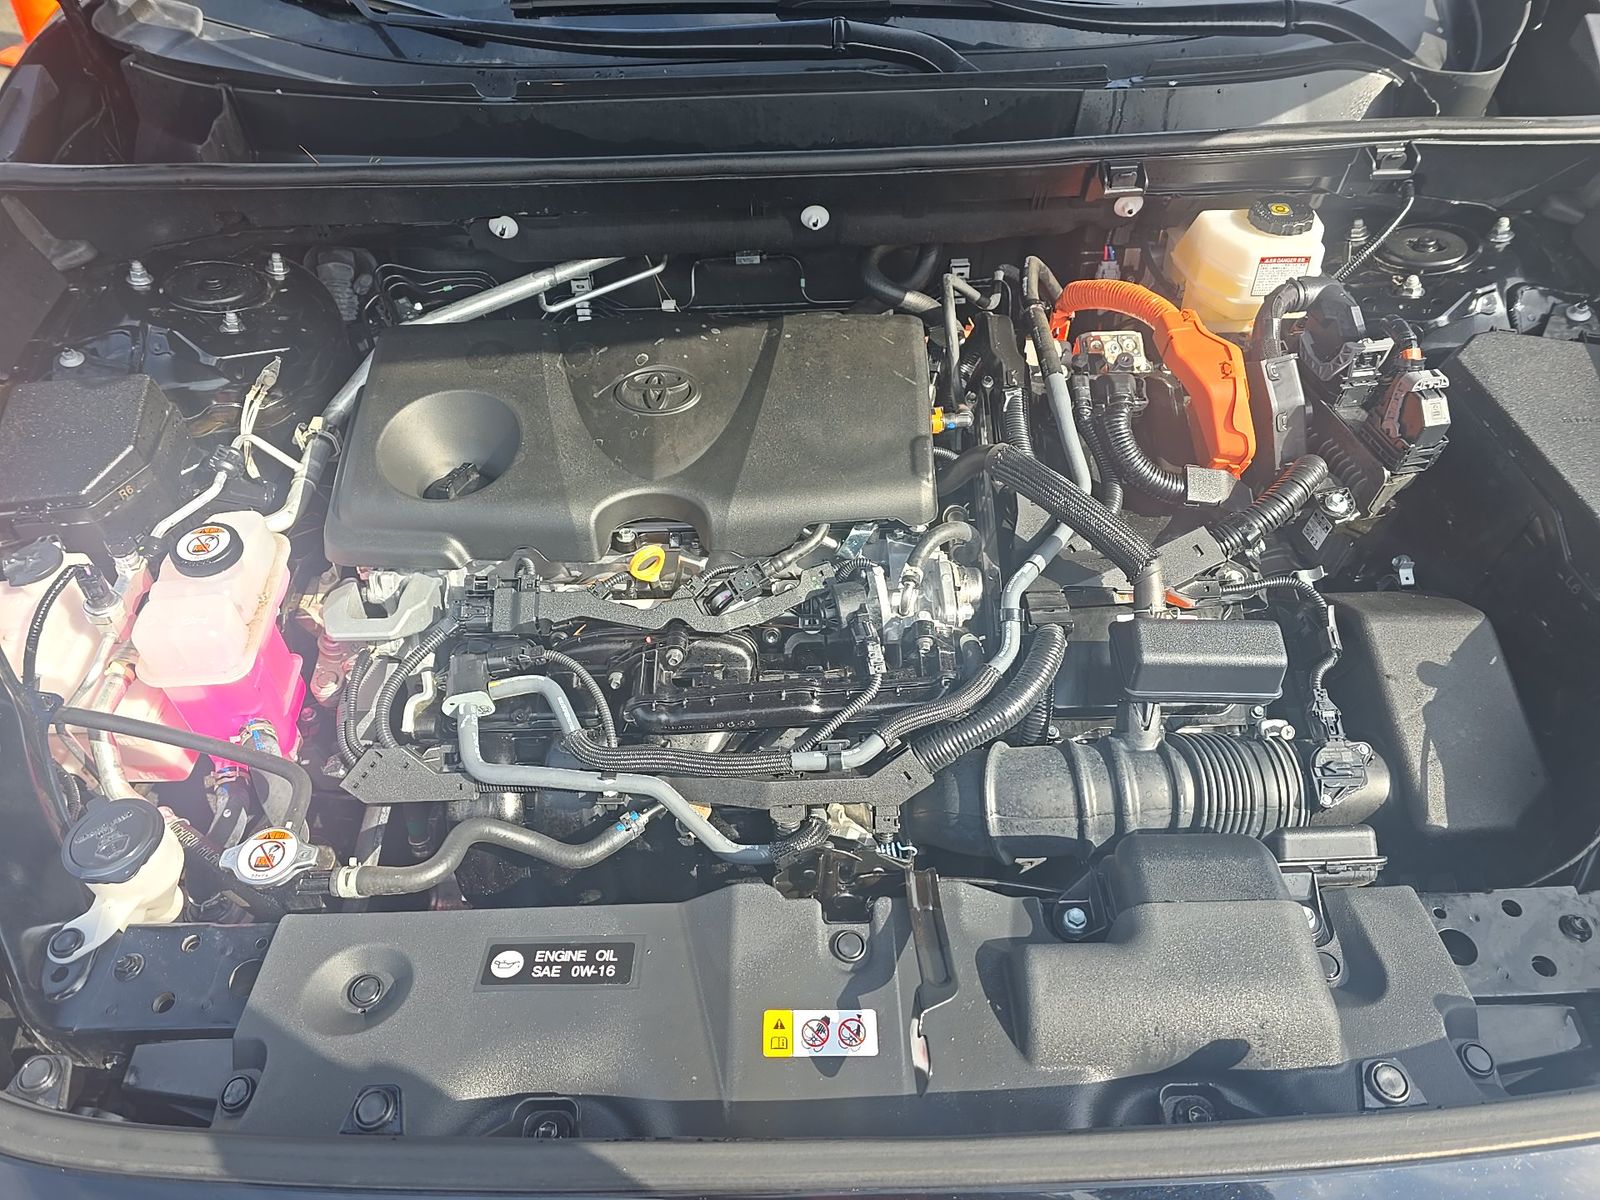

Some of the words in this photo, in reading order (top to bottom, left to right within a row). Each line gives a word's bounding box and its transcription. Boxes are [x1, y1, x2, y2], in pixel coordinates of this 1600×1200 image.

[118, 485, 134, 500] R6
[534, 950, 588, 962] ENGINE
[595, 949, 618, 961] OIL
[531, 965, 562, 977] SAE
[571, 965, 616, 977] 0W-16
